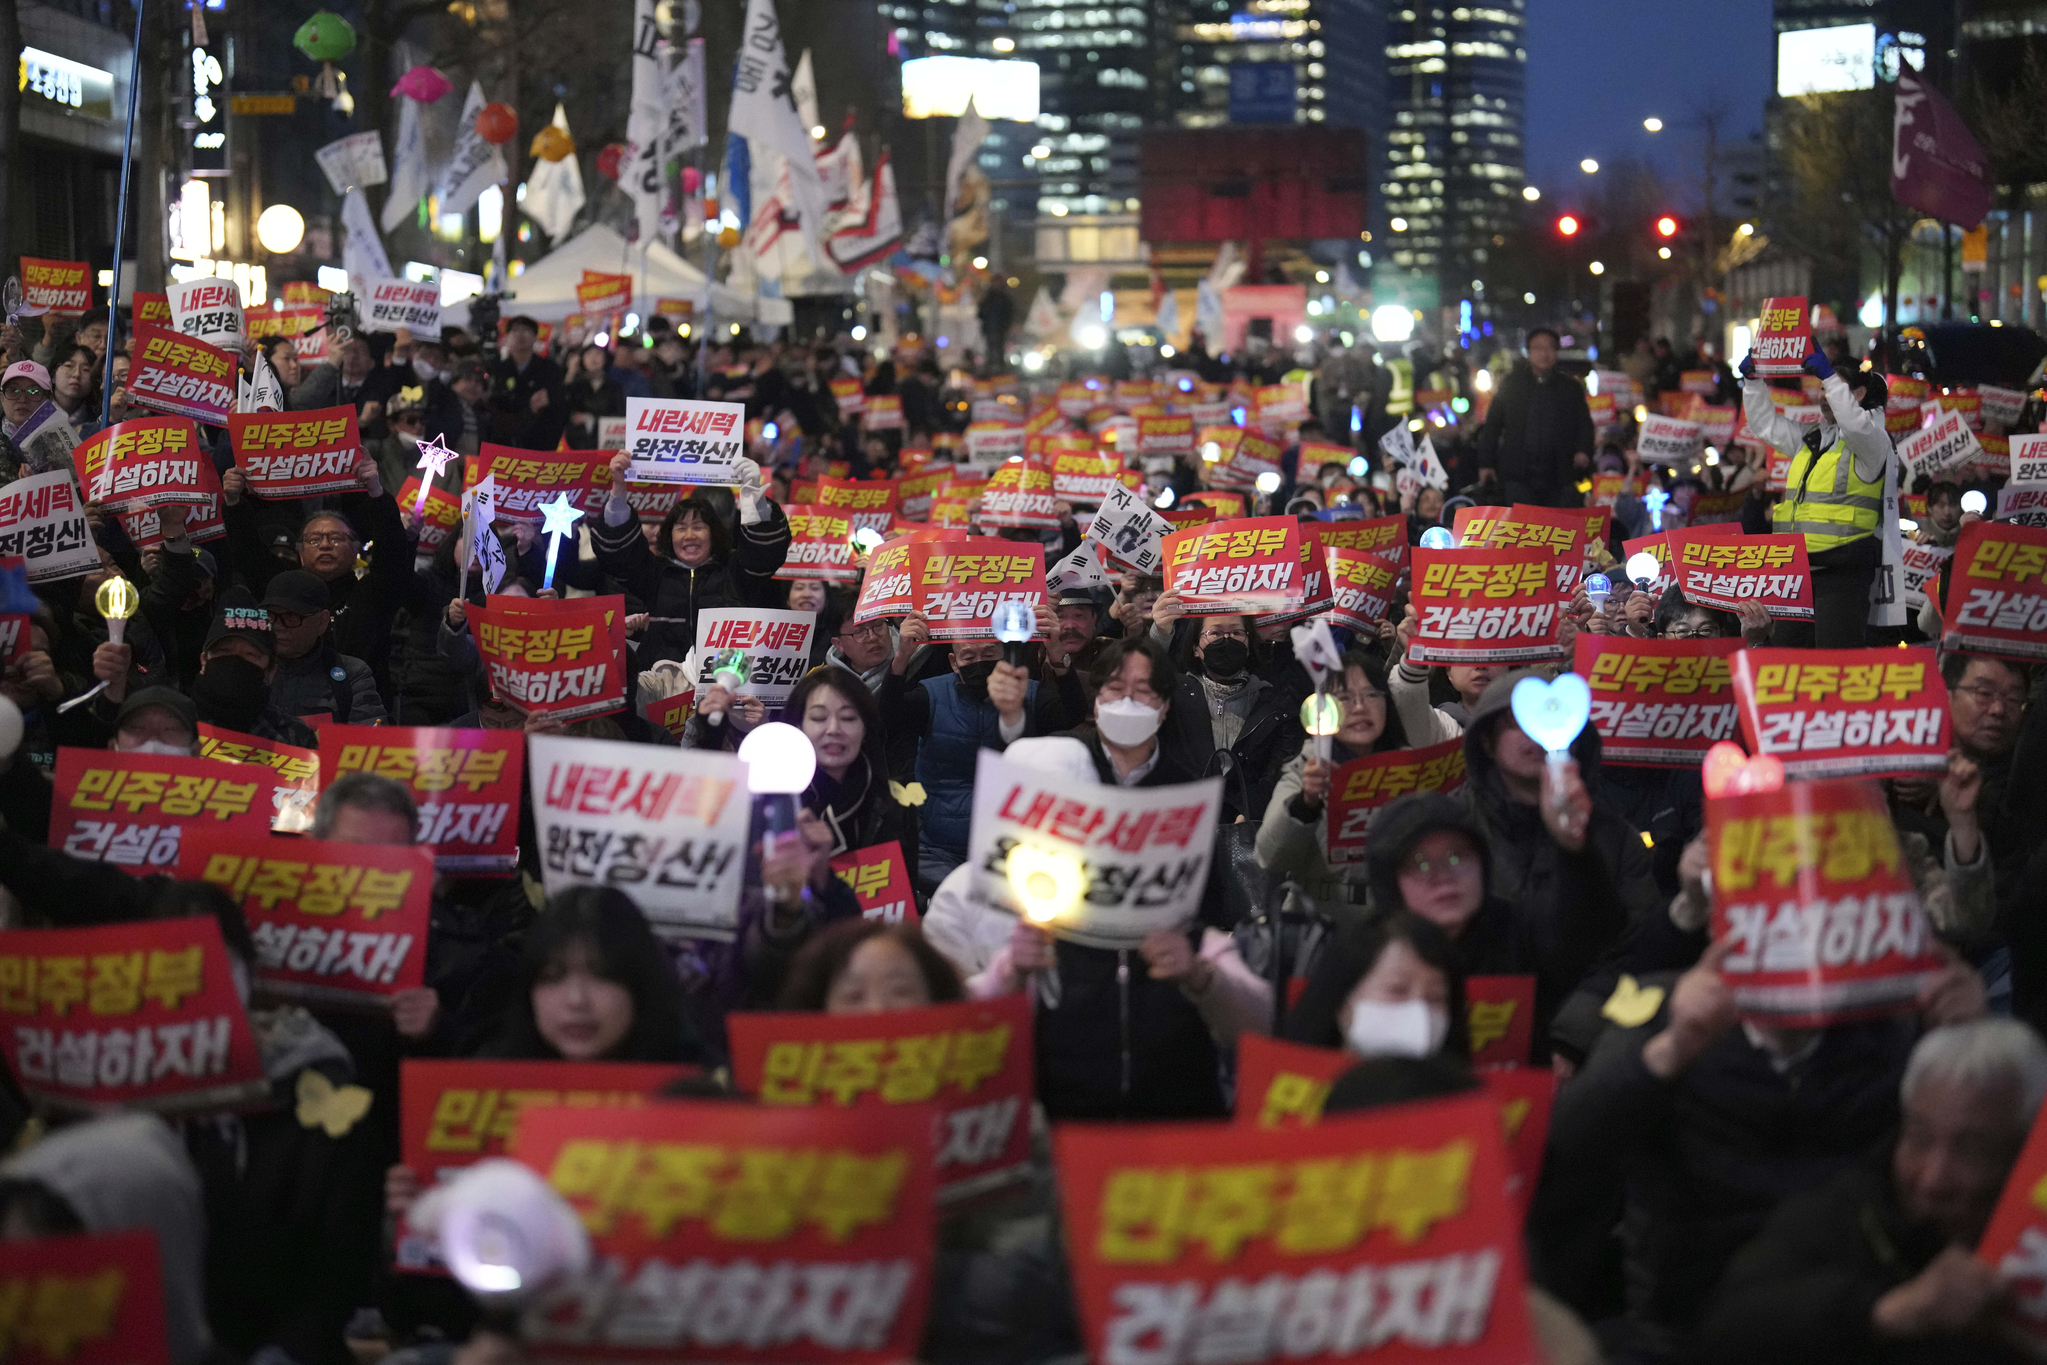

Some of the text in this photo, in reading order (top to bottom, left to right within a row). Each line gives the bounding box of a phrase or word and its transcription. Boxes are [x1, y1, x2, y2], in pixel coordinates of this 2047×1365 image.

[27, 265, 83, 286] 민주정부
[27, 286, 86, 306] 건설하자!
[1761, 307, 1800, 332] 주정부
[142, 338, 230, 378] 민주정부
[133, 367, 234, 408] 건설하자!
[242, 417, 347, 450] 민주정부
[637, 409, 738, 436] 내란세력
[1907, 414, 1960, 461] 내란세력
[85, 427, 188, 474] 민주정부
[246, 448, 355, 482] 건설하자!
[632, 438, 740, 466] 완전청산!
[2019, 441, 2047, 459] 내란
[89, 458, 198, 499] 건설하자!
[489, 455, 588, 485] 민주정부
[1053, 474, 1116, 493] 건설하자
[402, 488, 460, 527] 민주정
[820, 485, 891, 508] 민주정부
[787, 514, 848, 538] 주정부
[852, 512, 892, 533] 하자!
[785, 541, 850, 565] 설하자!
[1172, 527, 1288, 566] 민주정부
[1682, 542, 1796, 568] 민주정부
[922, 555, 1036, 585] 민주정부
[1173, 562, 1293, 596] 건설하자!
[1421, 561, 1548, 599] 민주정부
[1686, 570, 1803, 600] 건설하자!
[705, 620, 810, 652] 내란세력
[1419, 603, 1555, 640] 건설하자!
[481, 622, 594, 662] 민주정부
[492, 664, 606, 702] 건설하자!
[700, 656, 806, 686] 완청산!
[1590, 652, 1732, 695] 민주정부
[1756, 663, 1924, 705] 민주정부
[1592, 700, 1738, 741] 건설하자!
[1762, 707, 1941, 754] 건설하자!
[71, 768, 259, 820] 민주정부
[416, 803, 509, 845] 하자!
[999, 783, 1206, 853] 내란세력
[547, 823, 736, 892] 완전청산!
[202, 855, 414, 918] 민주정부
[253, 921, 413, 984] 설하자!
[14, 1016, 232, 1088] 건설하자!
[761, 1026, 1011, 1106] 민주정부
[1098, 1138, 1477, 1264] 민주정부
[1105, 1246, 1500, 1365] 건설하자!
